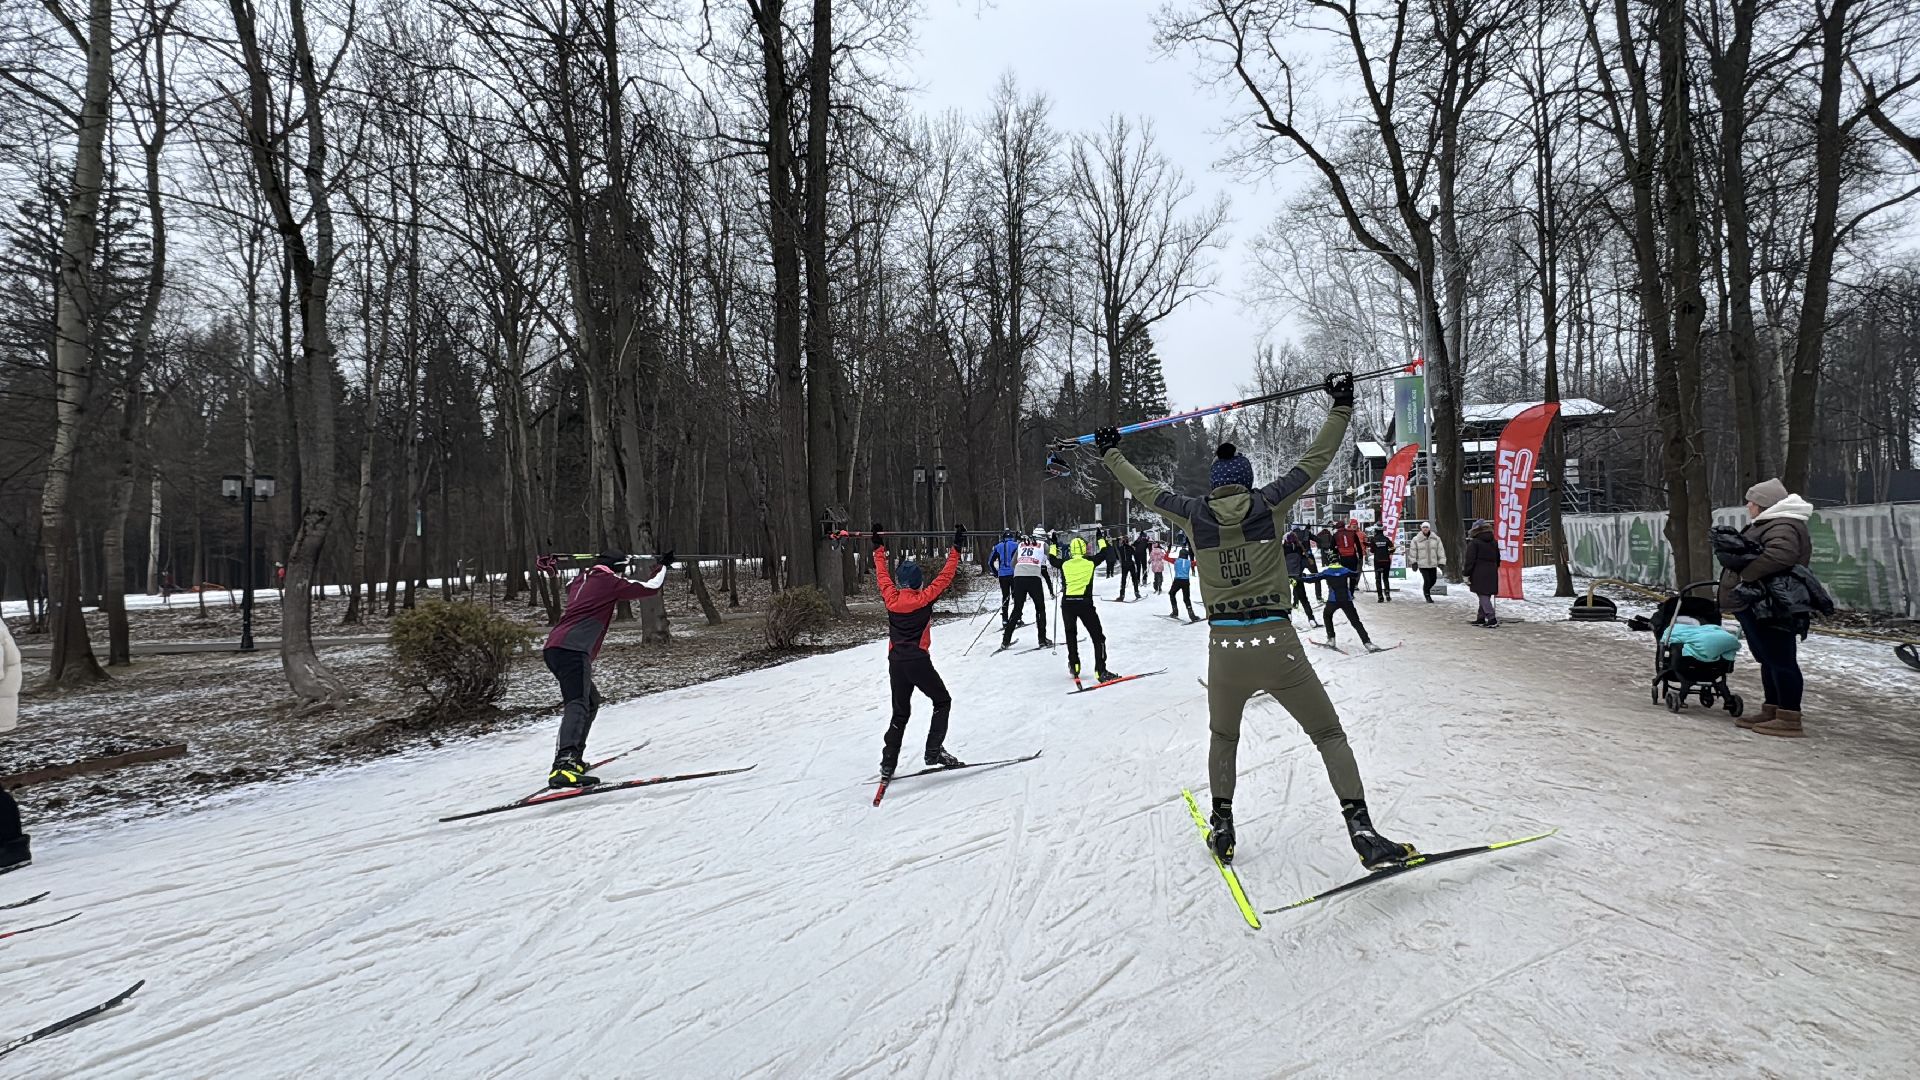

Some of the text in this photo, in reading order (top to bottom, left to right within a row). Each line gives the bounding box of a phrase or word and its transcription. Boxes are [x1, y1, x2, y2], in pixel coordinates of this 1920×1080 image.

[1505, 476, 1526, 563] СПОРТ
[1021, 547, 1034, 556] 26
[1219, 548, 1245, 564] DEVI
[1221, 563, 1251, 579] CLUB
